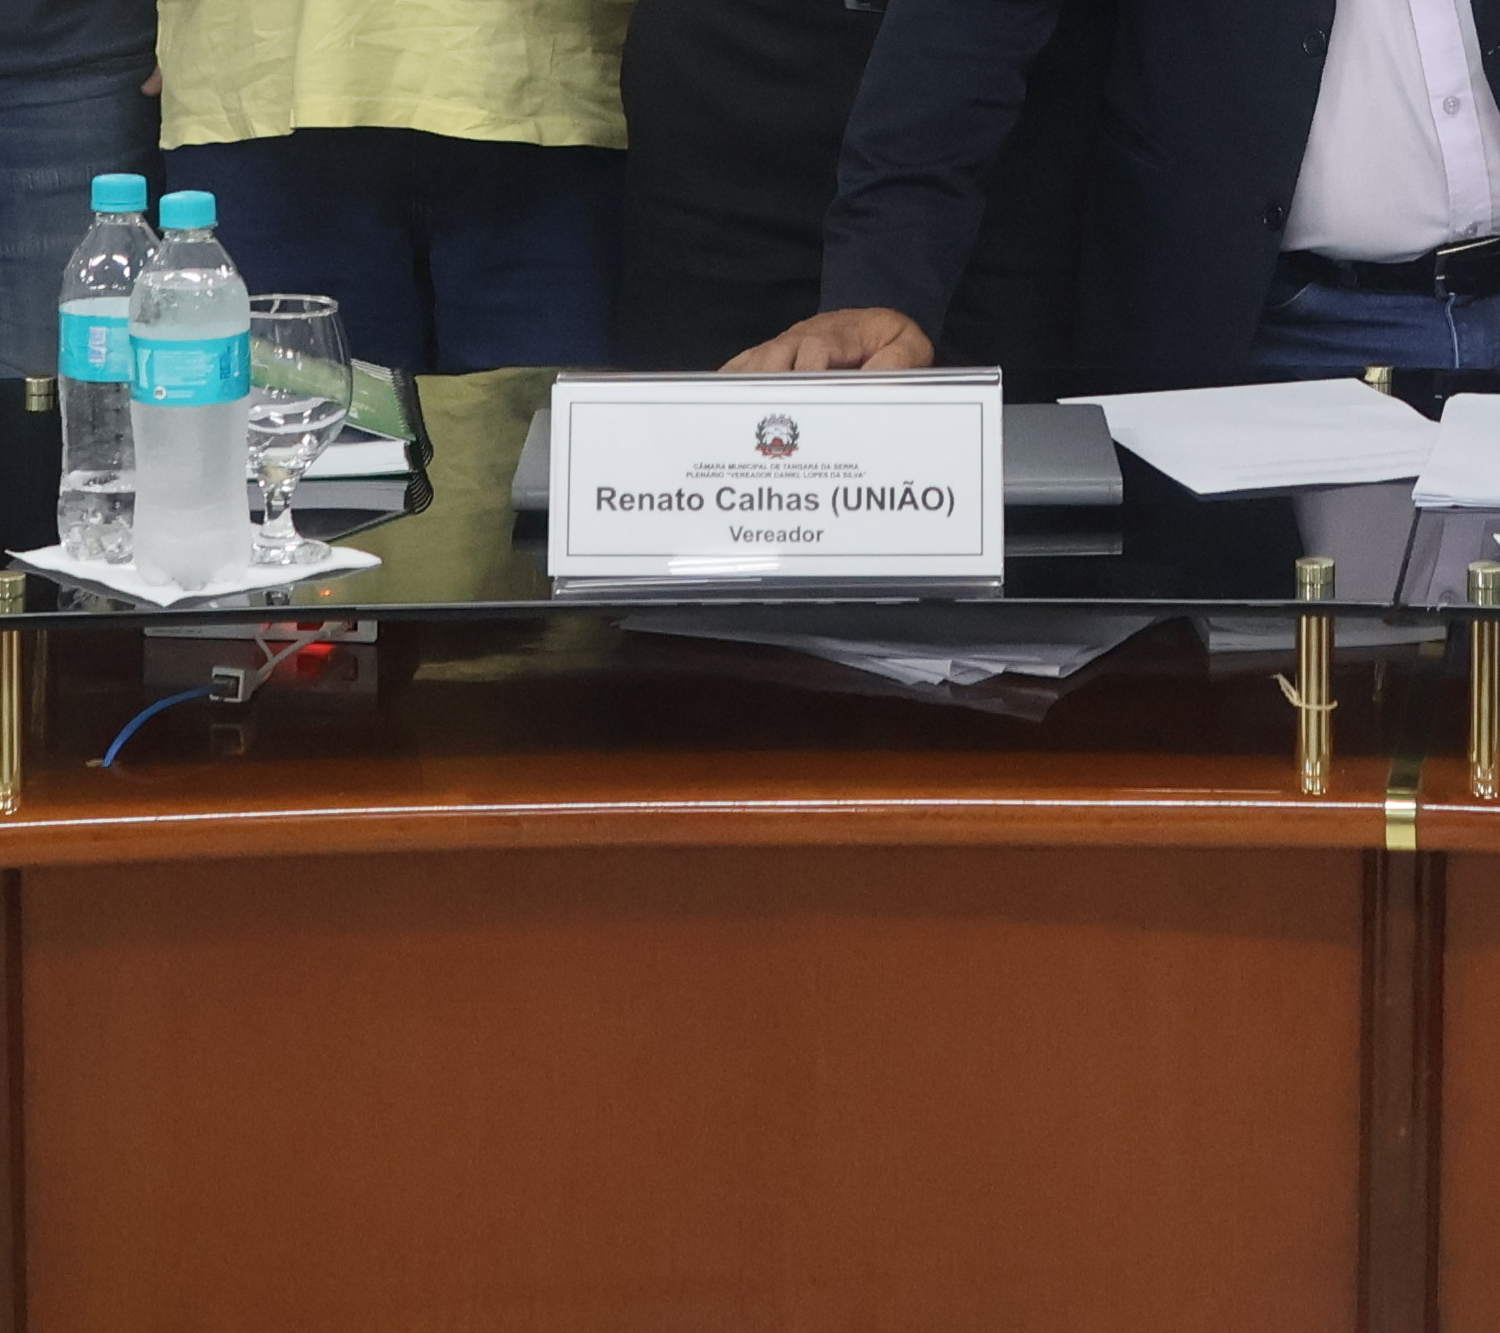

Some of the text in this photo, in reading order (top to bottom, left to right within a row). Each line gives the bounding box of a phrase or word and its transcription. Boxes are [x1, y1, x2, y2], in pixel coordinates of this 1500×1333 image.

[596, 480, 955, 518] Renato Calhas (UNIÃO)
[729, 525, 824, 543] Vereador
